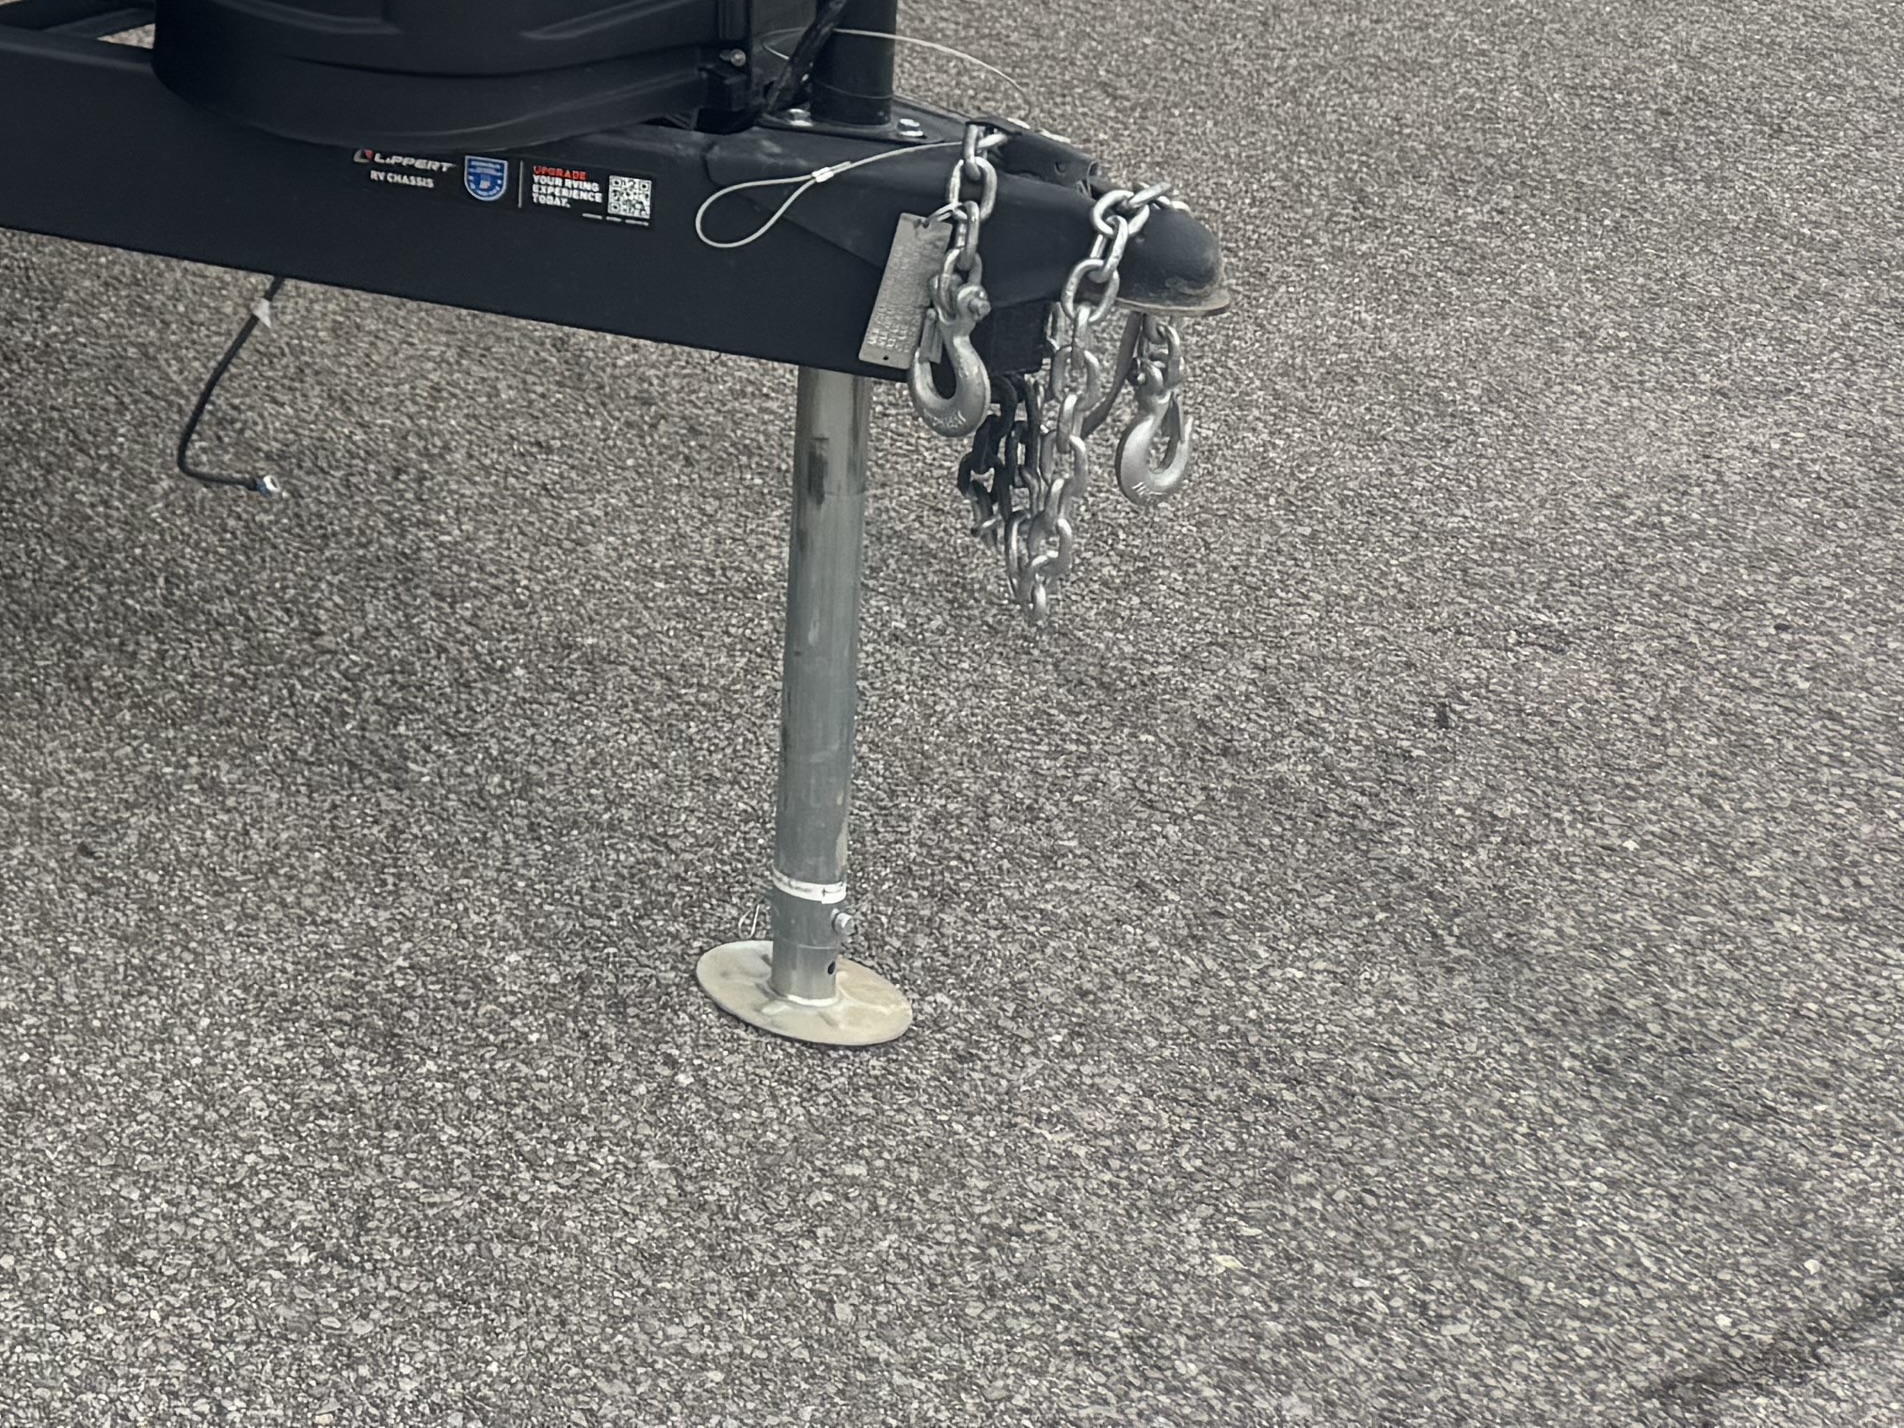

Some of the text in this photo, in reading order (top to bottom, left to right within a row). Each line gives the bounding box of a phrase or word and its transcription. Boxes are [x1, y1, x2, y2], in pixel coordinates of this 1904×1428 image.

[370, 169, 435, 188] RV CHASSIS
[532, 165, 589, 181] UPGRADE
[532, 174, 600, 193] YOUR RVING
[532, 183, 603, 204] EXPERIENCE
[532, 193, 571, 209] TODAY.
